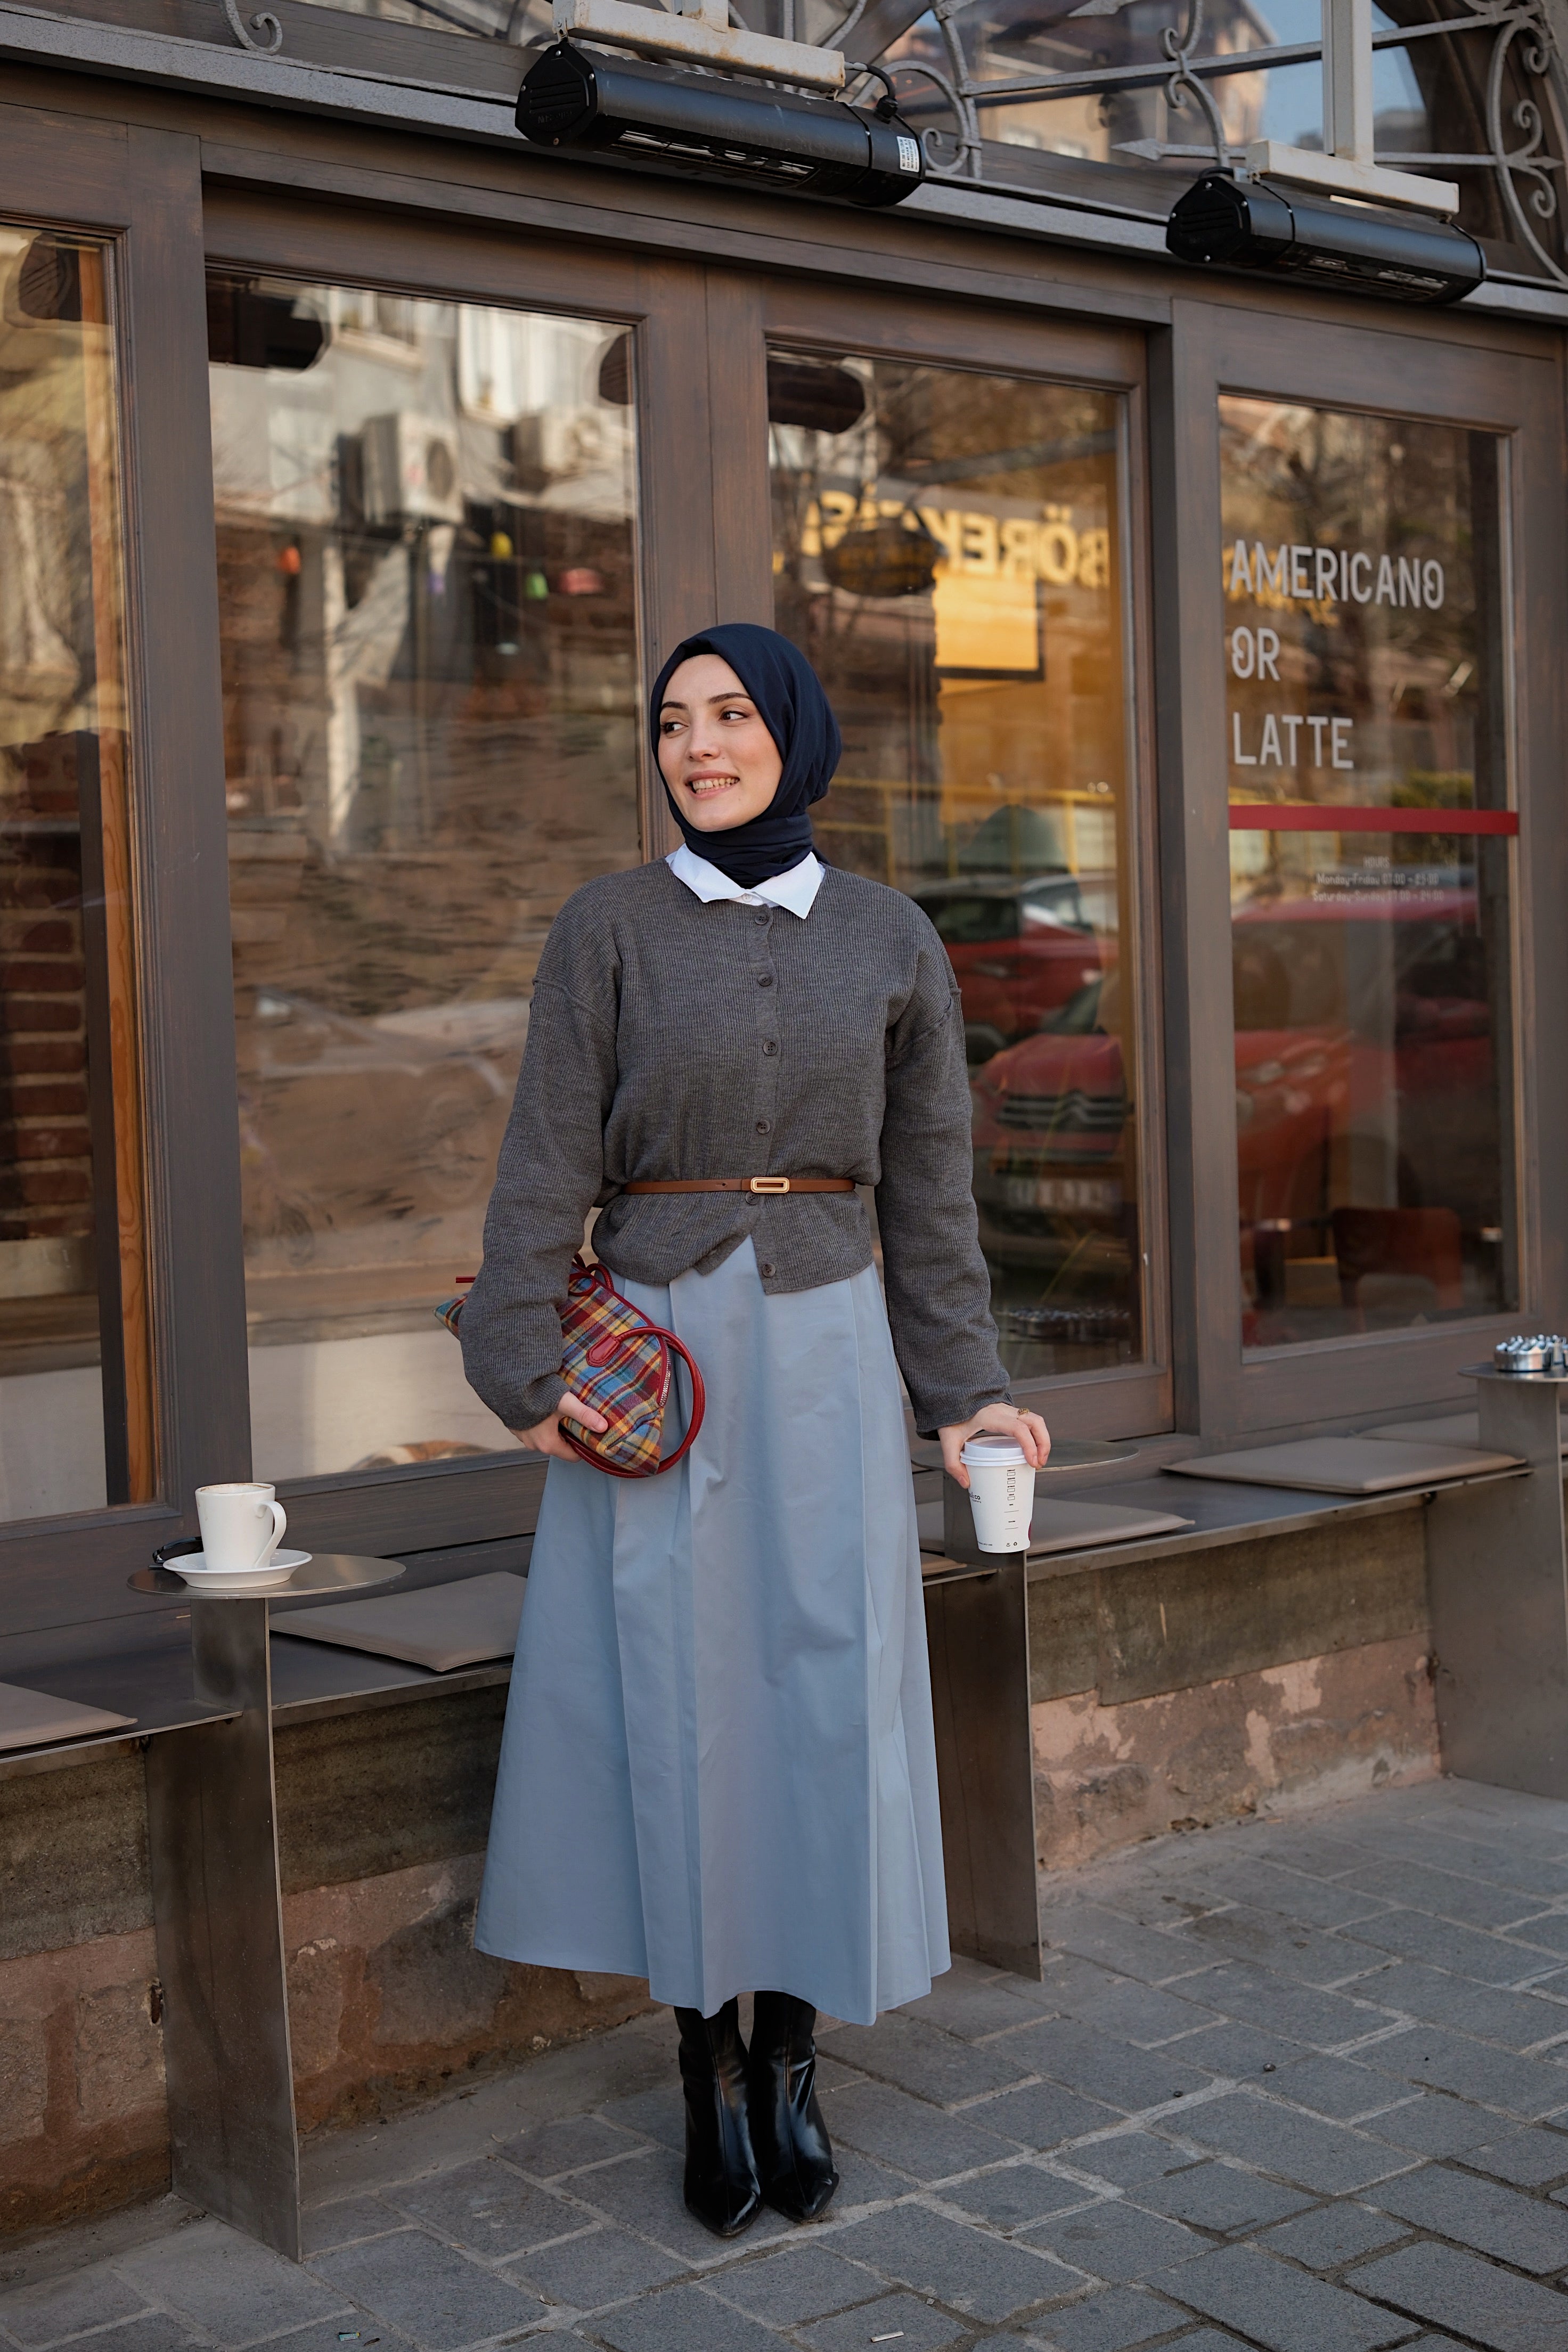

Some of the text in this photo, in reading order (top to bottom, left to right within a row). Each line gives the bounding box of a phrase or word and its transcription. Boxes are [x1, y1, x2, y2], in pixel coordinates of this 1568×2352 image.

[1230, 539, 1444, 610] AMERICANO
[1232, 626, 1281, 681] OR
[1232, 712, 1354, 769] LATTE
[1363, 856, 1390, 868] HOURS
